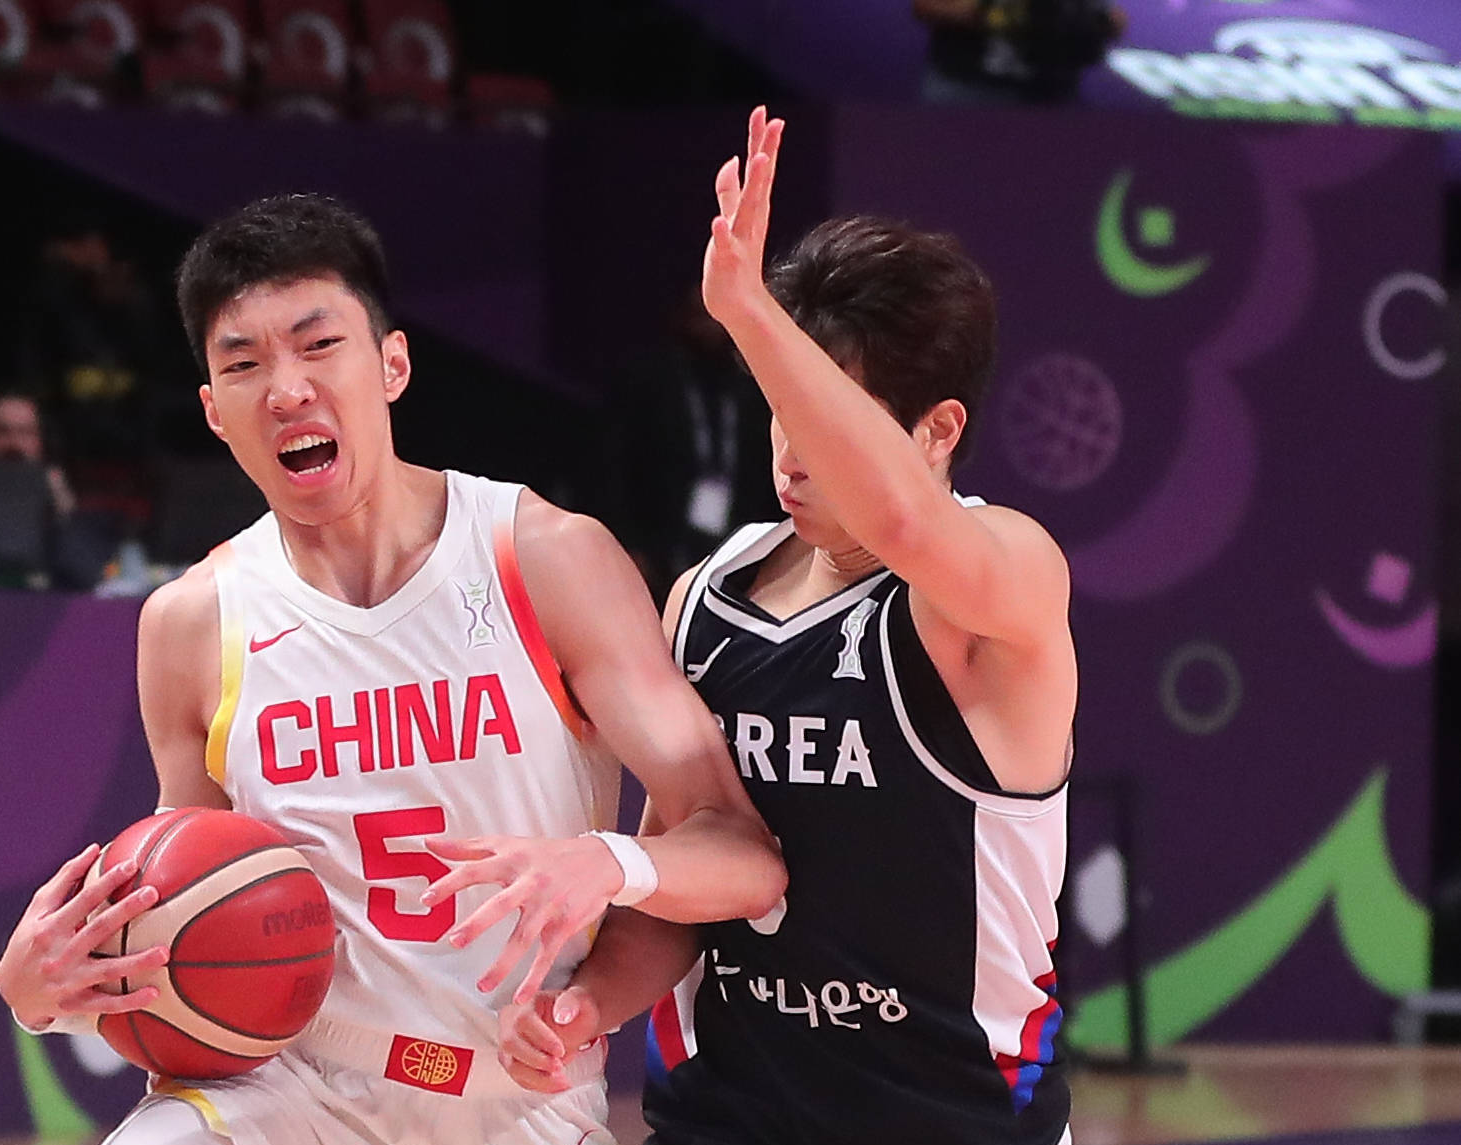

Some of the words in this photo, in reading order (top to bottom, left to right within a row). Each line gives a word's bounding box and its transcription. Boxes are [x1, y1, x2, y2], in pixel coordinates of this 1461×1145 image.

[256, 672, 523, 786] CHINA
[714, 711, 879, 788] REA
[352, 805, 456, 944] 5
